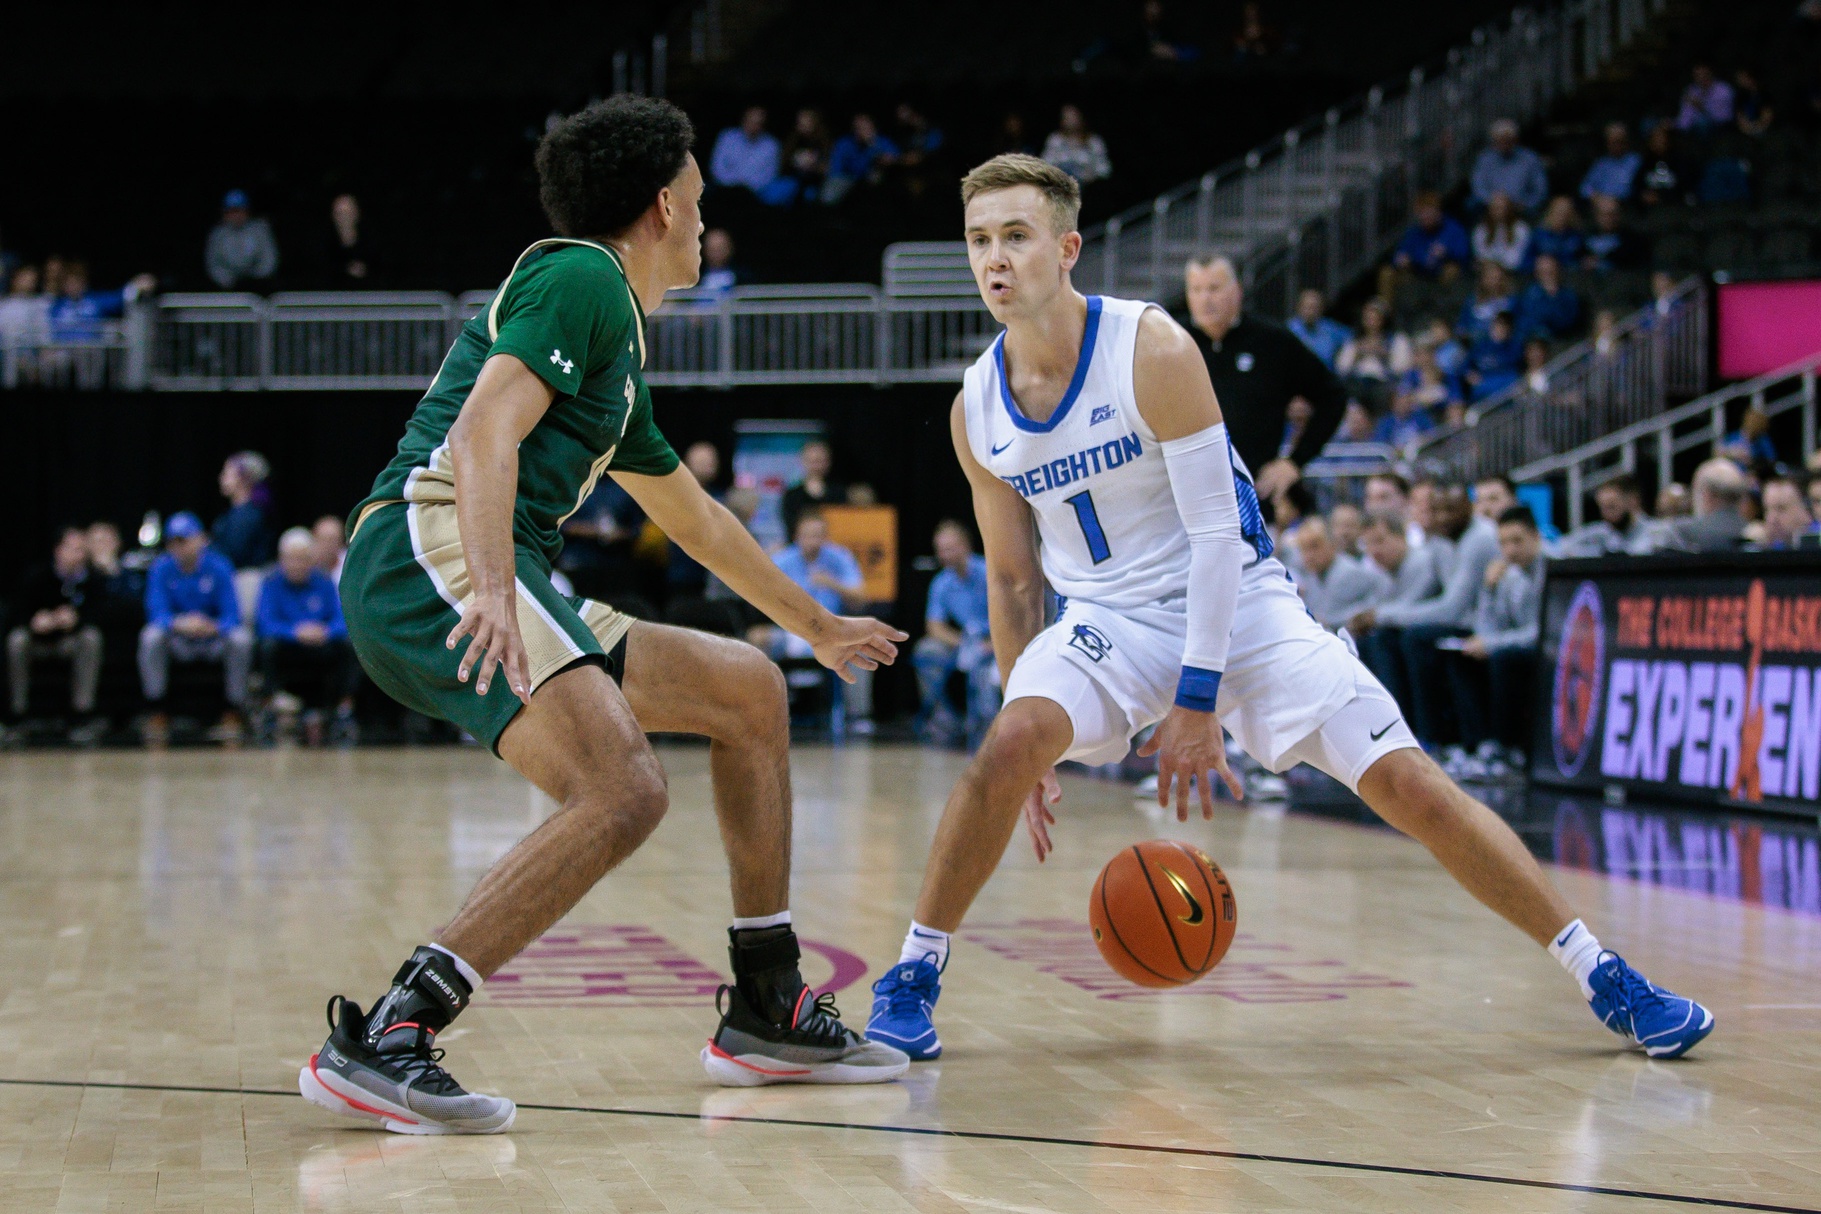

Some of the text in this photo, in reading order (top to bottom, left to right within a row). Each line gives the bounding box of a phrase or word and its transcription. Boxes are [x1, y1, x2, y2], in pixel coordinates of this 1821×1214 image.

[1090, 409, 1116, 424] EAST
[1092, 404, 1110, 416] BIG
[1062, 489, 1112, 566] 1
[1616, 596, 1655, 649] THE
[1656, 596, 1746, 650] COLLEGE
[1600, 658, 1821, 801] EXPEREN
